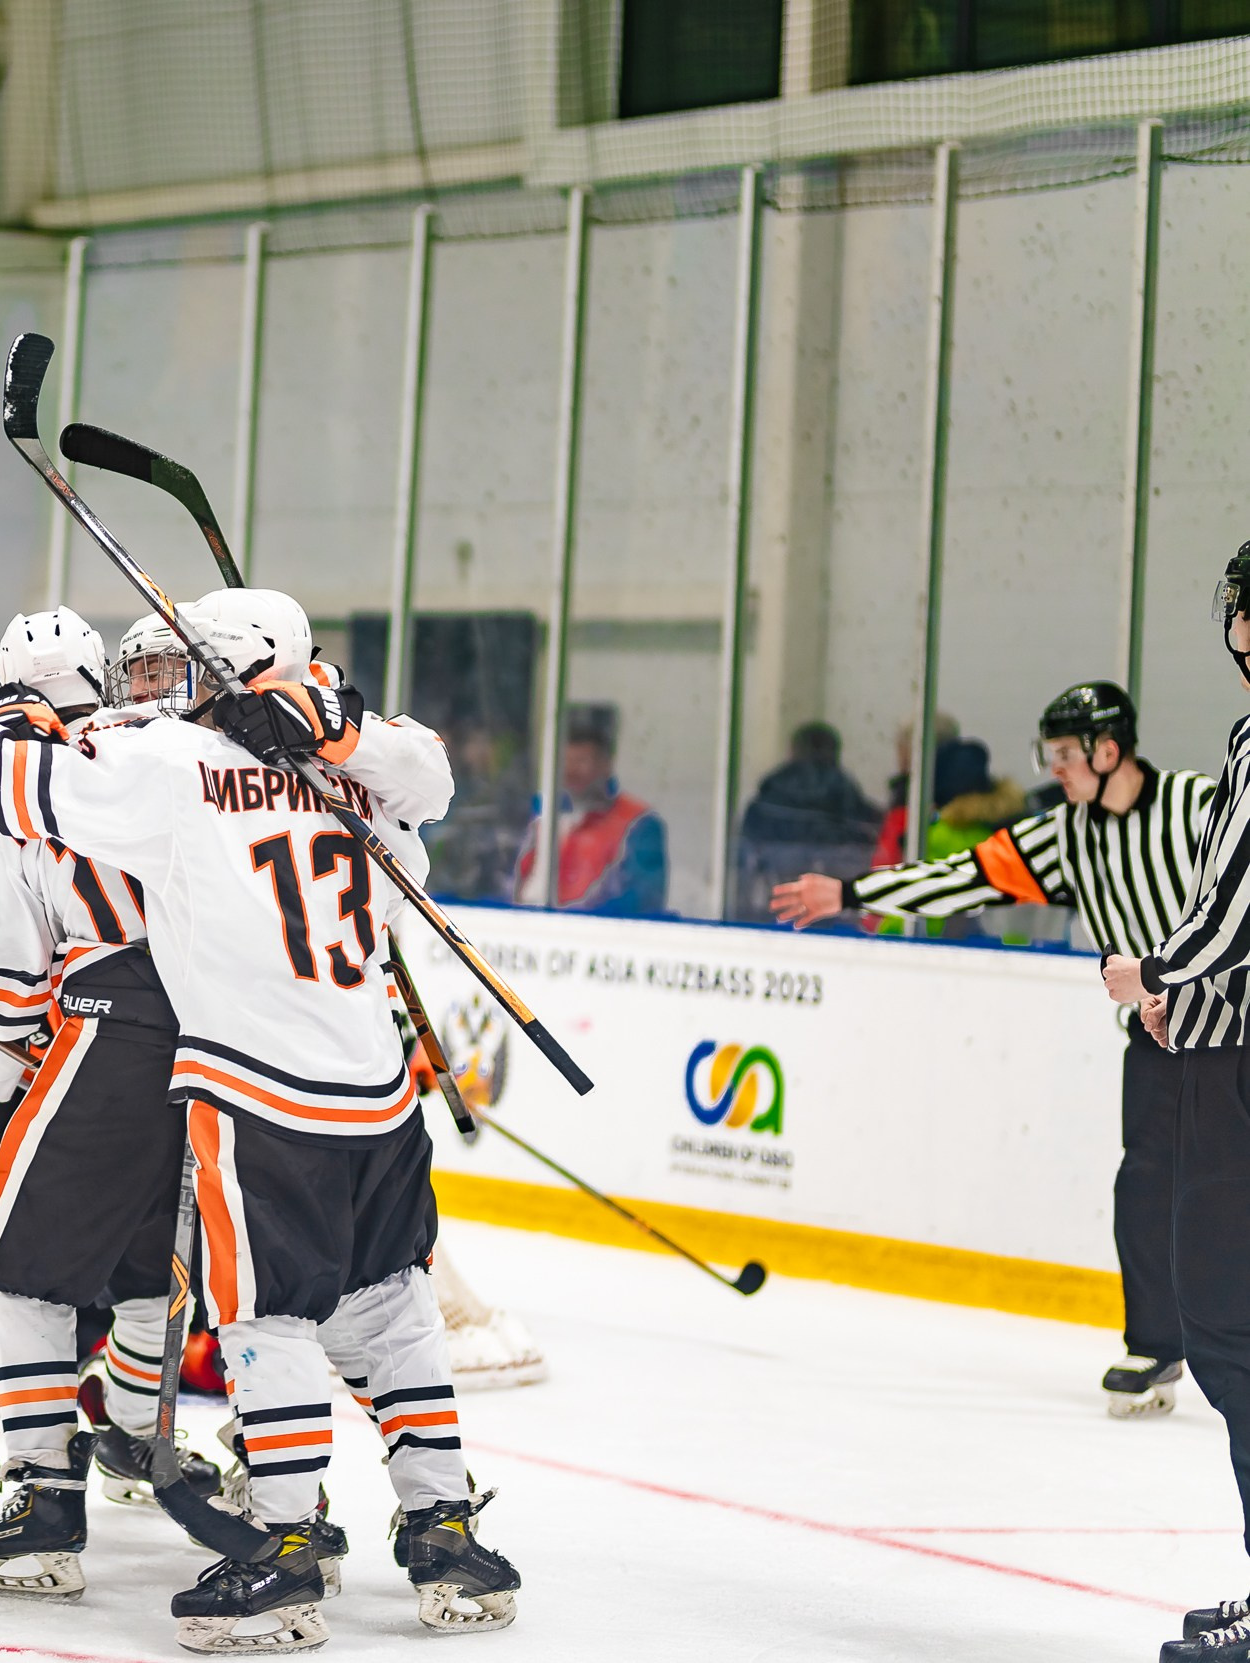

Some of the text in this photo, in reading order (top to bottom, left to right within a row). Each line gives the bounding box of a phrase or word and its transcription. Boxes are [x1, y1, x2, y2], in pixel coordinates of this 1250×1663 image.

[249, 830, 377, 990] 13
[587, 954, 637, 985] ASIA
[646, 959, 754, 999] KUZBASS
[763, 969, 823, 1005] 2023
